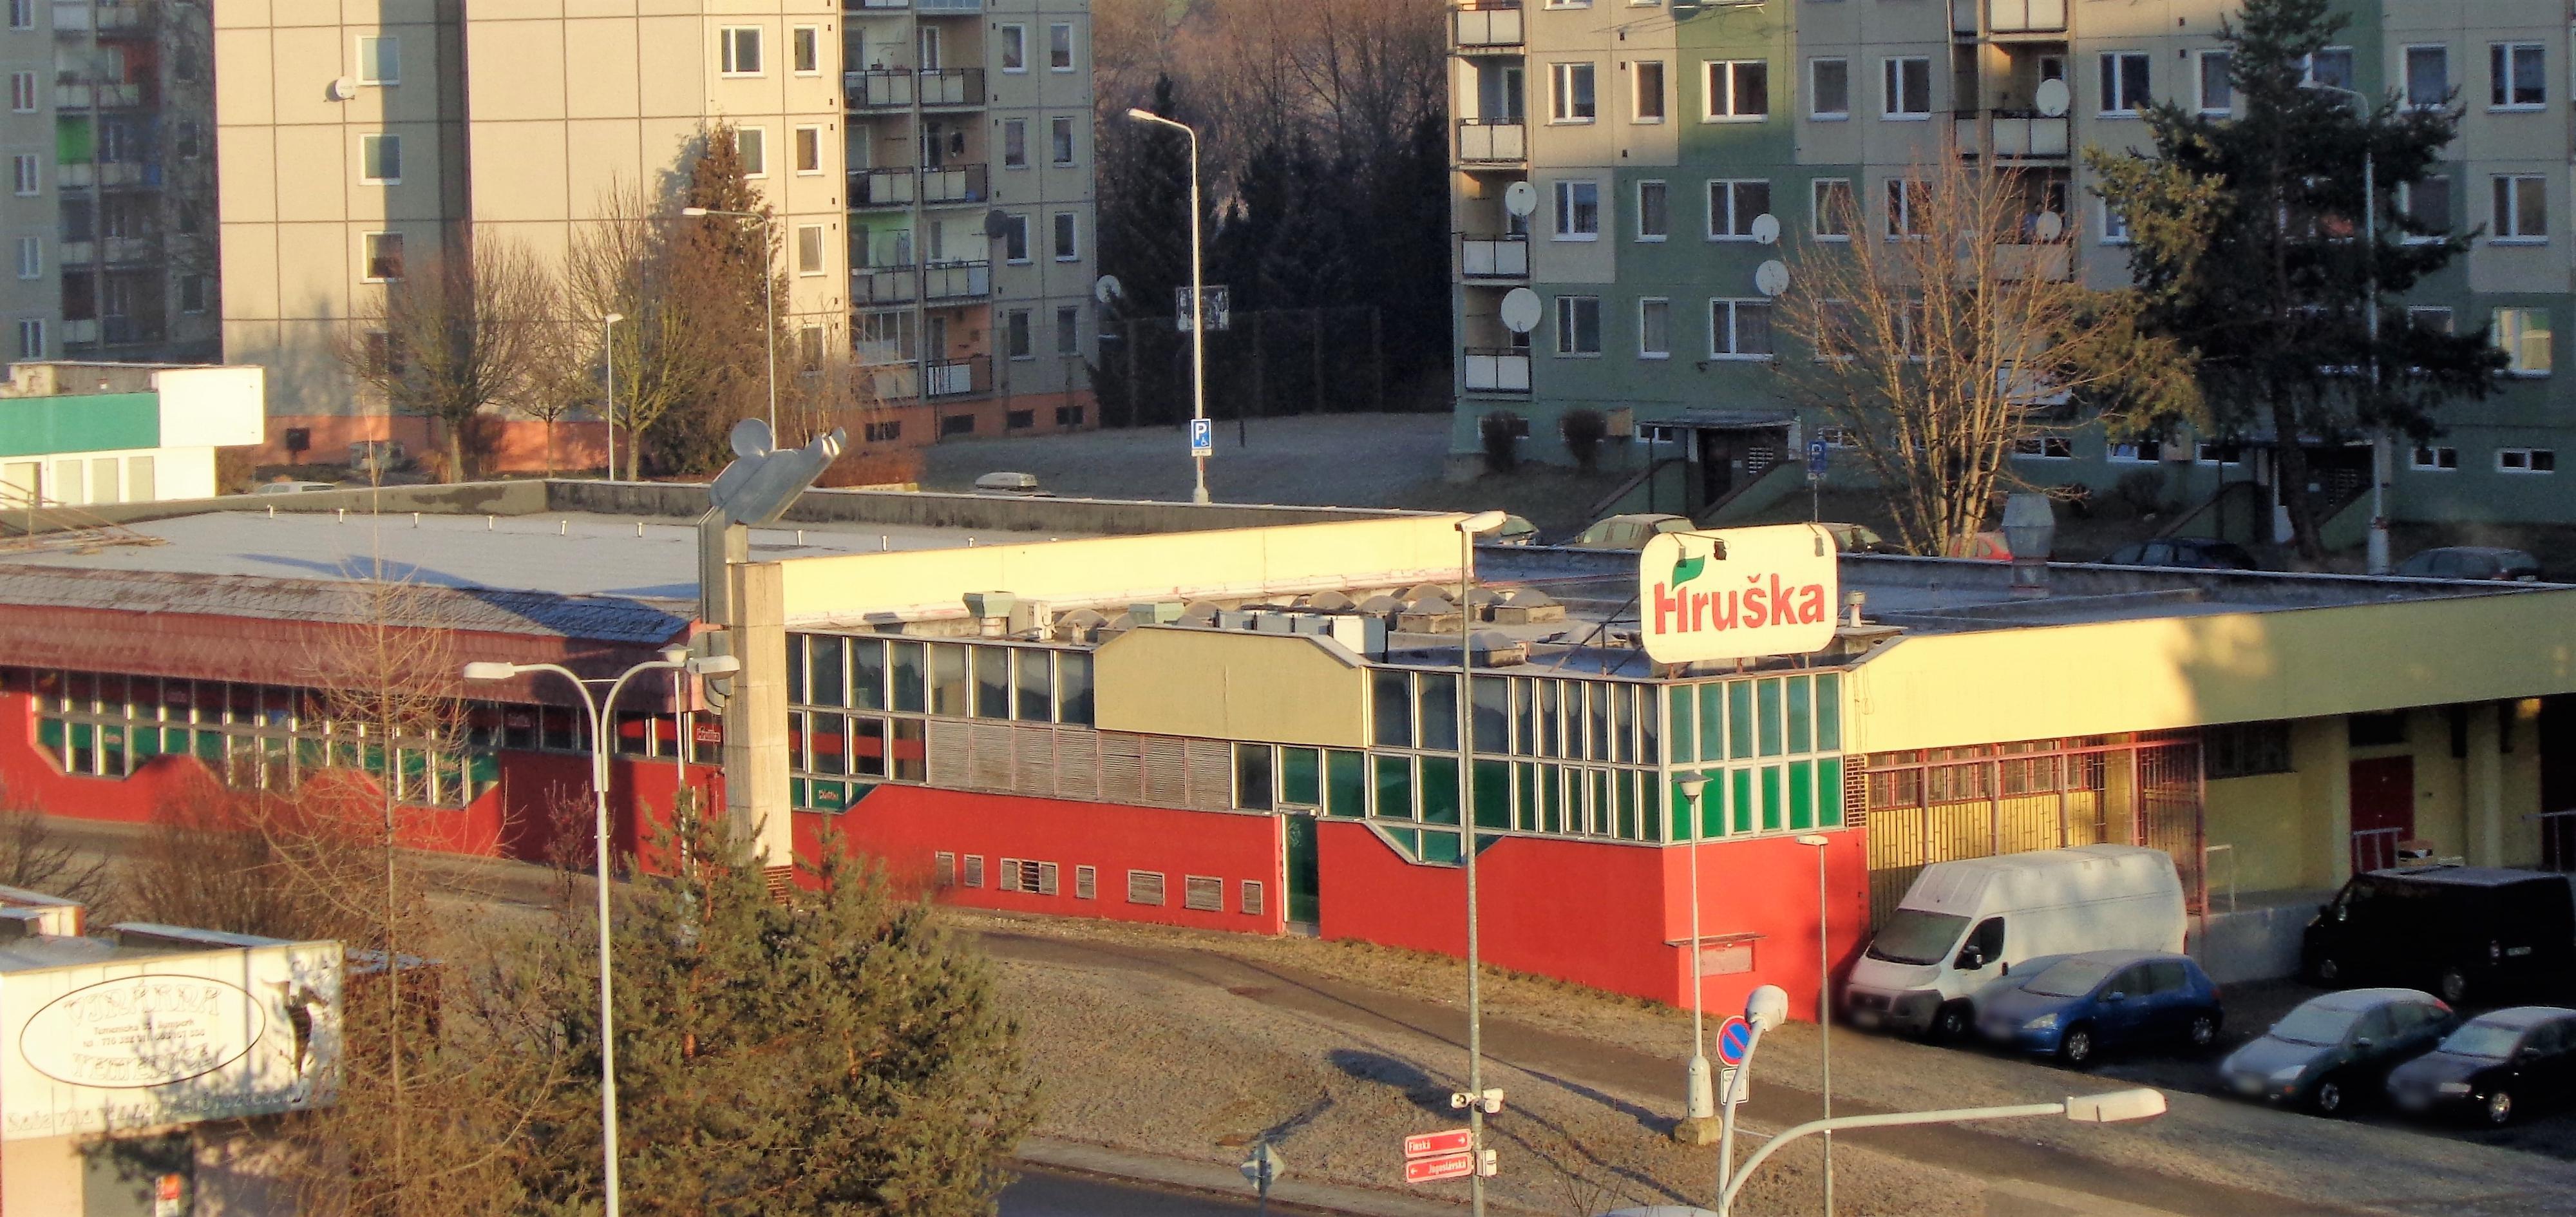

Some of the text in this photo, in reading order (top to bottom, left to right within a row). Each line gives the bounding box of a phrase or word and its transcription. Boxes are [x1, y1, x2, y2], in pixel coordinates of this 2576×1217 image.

[1195, 423, 1207, 441] P
[1654, 573, 1824, 635] Hruška
[1408, 1139, 1431, 1151] Finská
